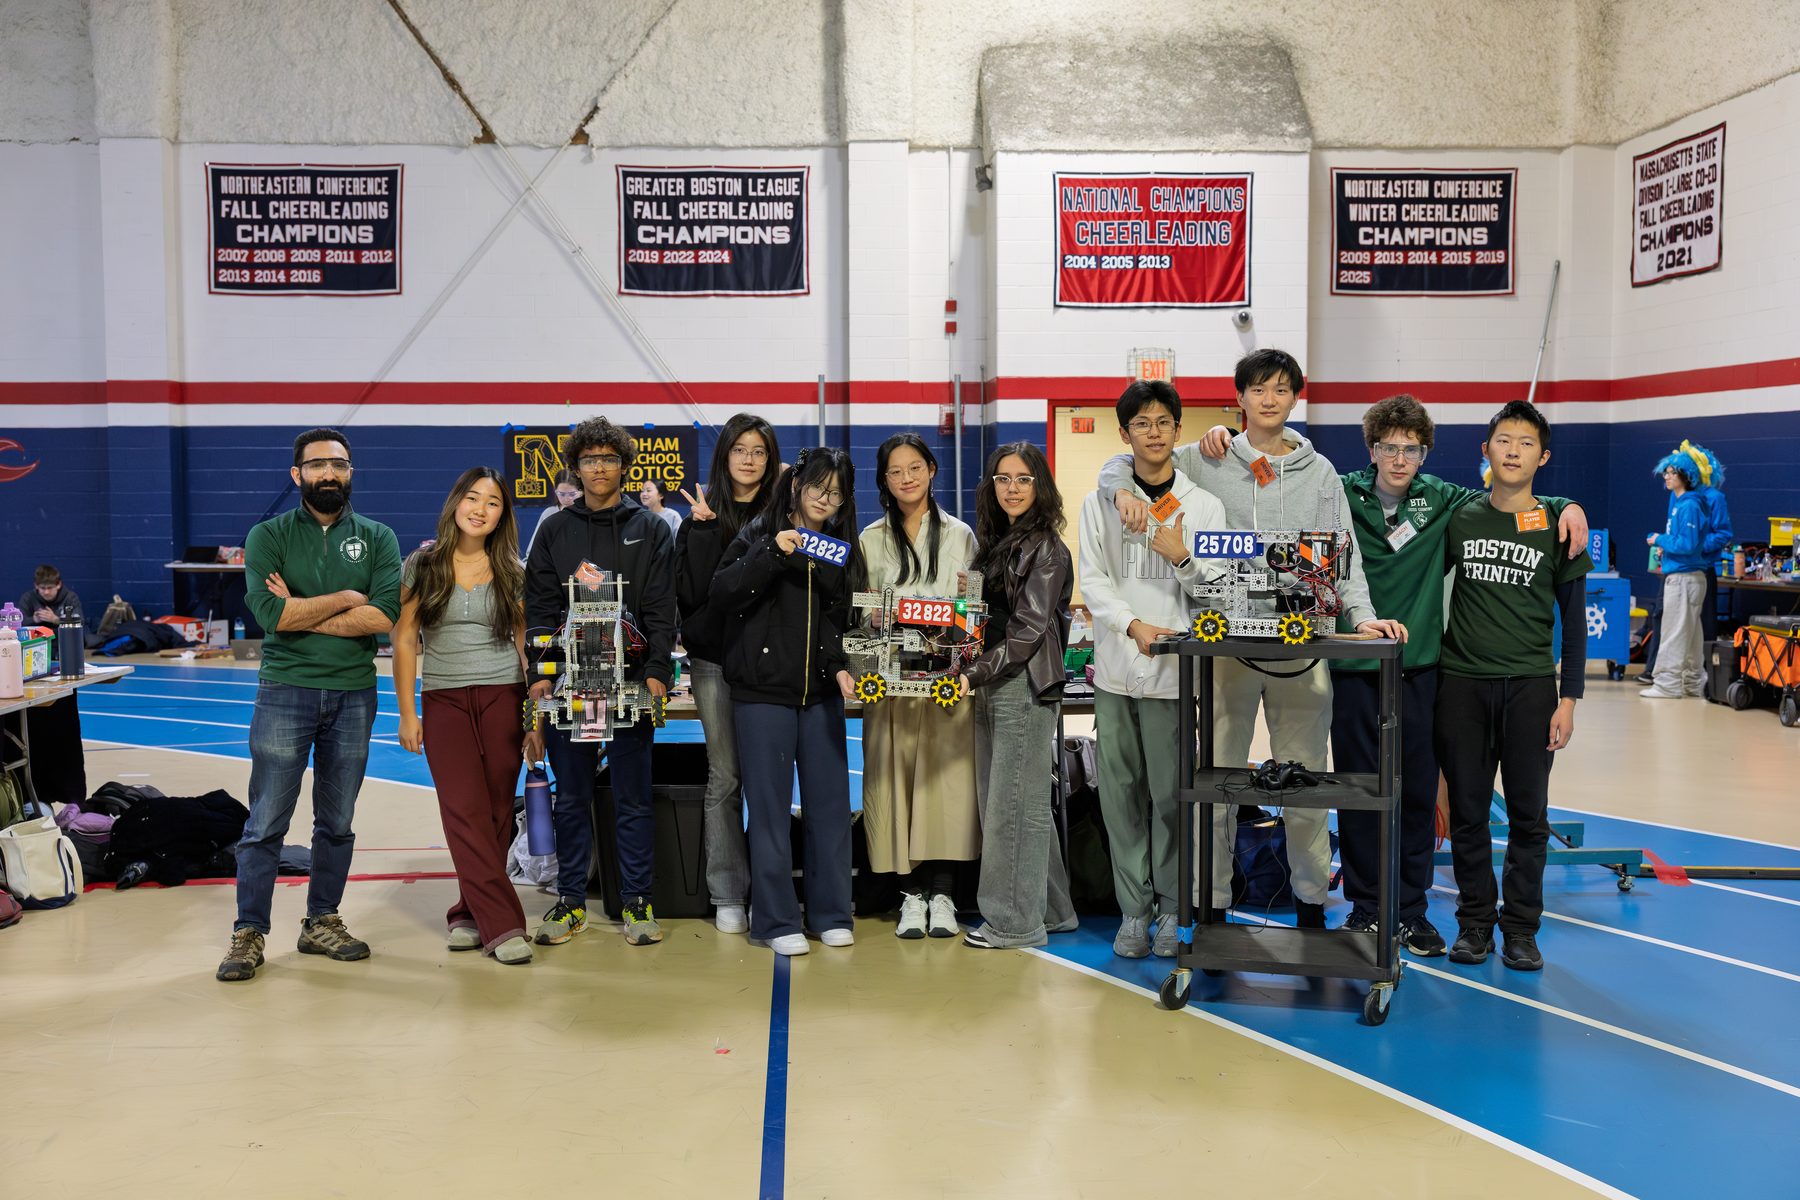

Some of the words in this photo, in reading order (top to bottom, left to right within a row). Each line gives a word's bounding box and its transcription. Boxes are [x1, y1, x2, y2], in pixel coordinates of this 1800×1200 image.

[1640, 146, 1693, 183] MASSACHUSETTS
[1696, 137, 1717, 163] STATE
[220, 176, 311, 195] NORTHEASTERN
[317, 177, 389, 195] CONFERENCE
[626, 177, 685, 196] GREATER
[691, 177, 742, 196] BOSTON
[749, 178, 800, 196] LEAGUE
[1344, 179, 1429, 198] NORTHEASTERN
[1434, 180, 1503, 198] CONFERENCE
[1638, 181, 1663, 207] DIVISION
[1695, 163, 1717, 187] CO-ED
[220, 200, 262, 219] FALL
[269, 201, 389, 219] CHEERLEADING
[1062, 187, 1143, 212] NATIONAL
[1150, 187, 1244, 213] CHAMPIONS
[1640, 207, 1656, 230] FALL
[1659, 189, 1714, 223] CHEERLEADING
[633, 201, 672, 220] FALL
[679, 202, 794, 220] CHEERLEADING
[1349, 204, 1397, 222] WINTER
[1402, 204, 1499, 222] CHEERLEADING
[236, 225, 374, 243] CHAMPIONS
[637, 225, 791, 244] CHAMPIONS
[1075, 220, 1231, 246] CHEERLEADING
[1358, 227, 1488, 245] CHAMPIONS
[1640, 215, 1713, 252] CHAMPIONS
[217, 249, 248, 262] 2007
[253, 250, 285, 263] 2008
[290, 249, 321, 262] 2009
[325, 250, 355, 263] 2011
[361, 250, 393, 263] 2012
[628, 249, 659, 263] 2019
[663, 250, 695, 263] 2022
[698, 250, 730, 263] 2024
[1064, 255, 1096, 269] 2004
[1101, 255, 1134, 269] 2005
[1138, 255, 1170, 269] 2013
[1340, 251, 1370, 264] 2009
[1374, 251, 1404, 264] 2013
[1407, 251, 1437, 264] 2014
[1441, 251, 1471, 264] 2015
[1475, 250, 1505, 264] 2019
[1657, 246, 1693, 273] 2021
[218, 269, 250, 283] 2013
[254, 269, 286, 283] 2014
[290, 270, 320, 283] 2016
[1339, 270, 1370, 283] 2025
[1141, 358, 1167, 379] EXIT
[1072, 418, 1094, 433] EXIT
[629, 437, 679, 452] DHAM
[632, 453, 684, 465] CHOOL
[630, 466, 685, 480] OTICS
[1154, 497, 1171, 513] DRIVER
[1409, 498, 1428, 507] BTA
[799, 532, 847, 564] 32822
[1198, 534, 1254, 554] 25708
[1592, 534, 1602, 561] 6055
[1462, 538, 1544, 570] BOSTON
[1463, 561, 1535, 587] TRINITY
[902, 602, 952, 622] 32822
